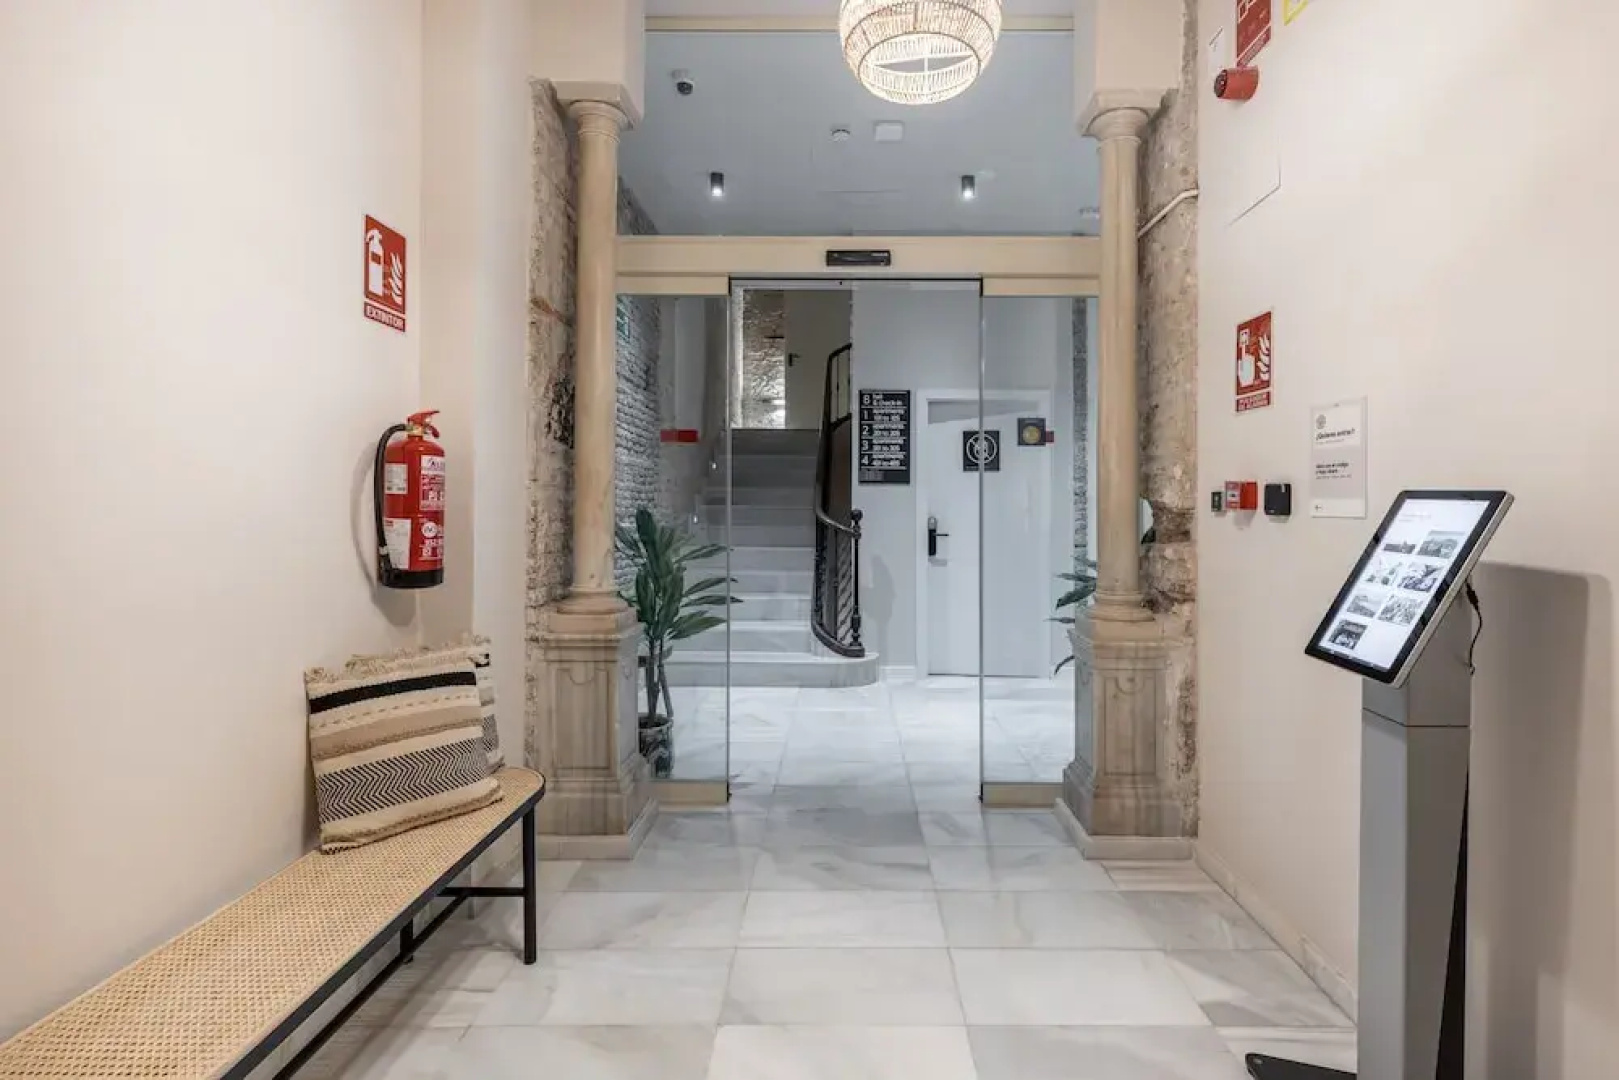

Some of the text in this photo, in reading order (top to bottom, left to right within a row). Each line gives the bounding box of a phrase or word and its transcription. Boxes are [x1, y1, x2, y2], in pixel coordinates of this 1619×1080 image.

[862, 425, 869, 435] 2
[862, 440, 869, 451] 3
[861, 454, 869, 465] 4
